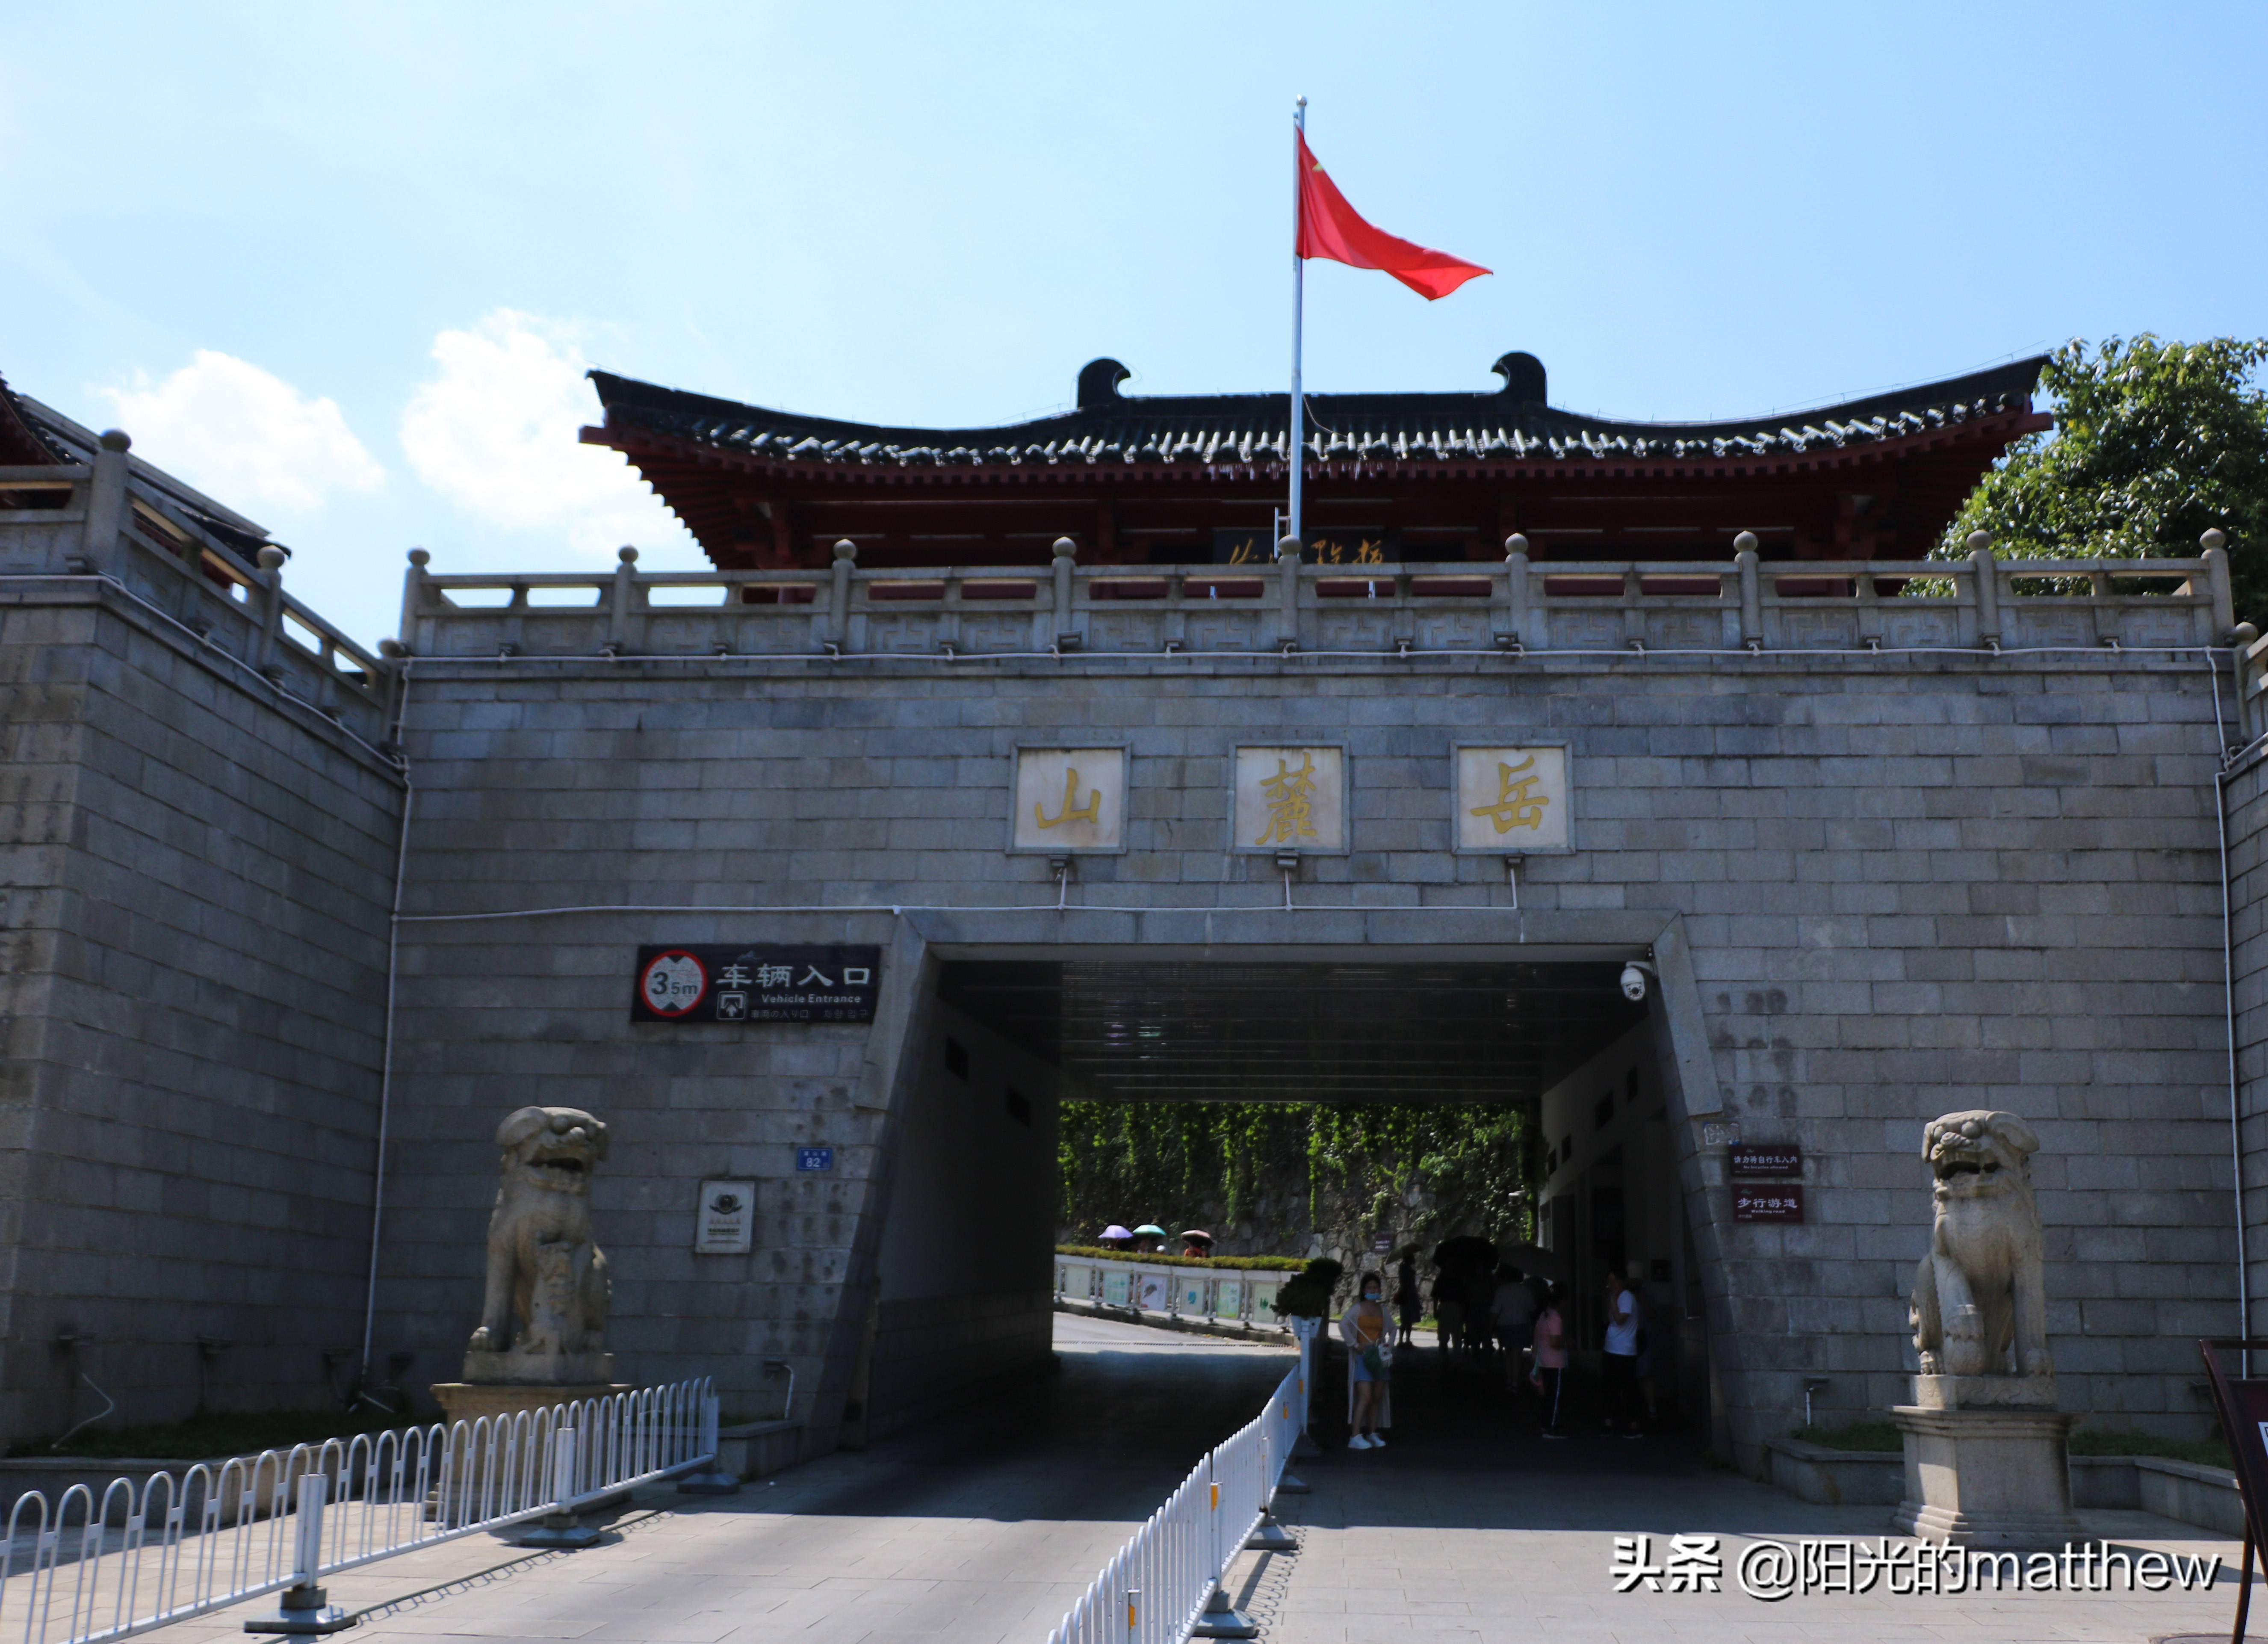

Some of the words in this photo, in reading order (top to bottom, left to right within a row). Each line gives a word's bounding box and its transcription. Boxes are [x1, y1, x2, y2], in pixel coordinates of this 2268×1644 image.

[716, 964, 870, 988] 车辆入口
[761, 994, 805, 1003] Vehicle
[808, 994, 862, 1003] Entrance
[806, 1157, 821, 1167] 82
[1738, 1198, 1798, 1208] 步行游道
